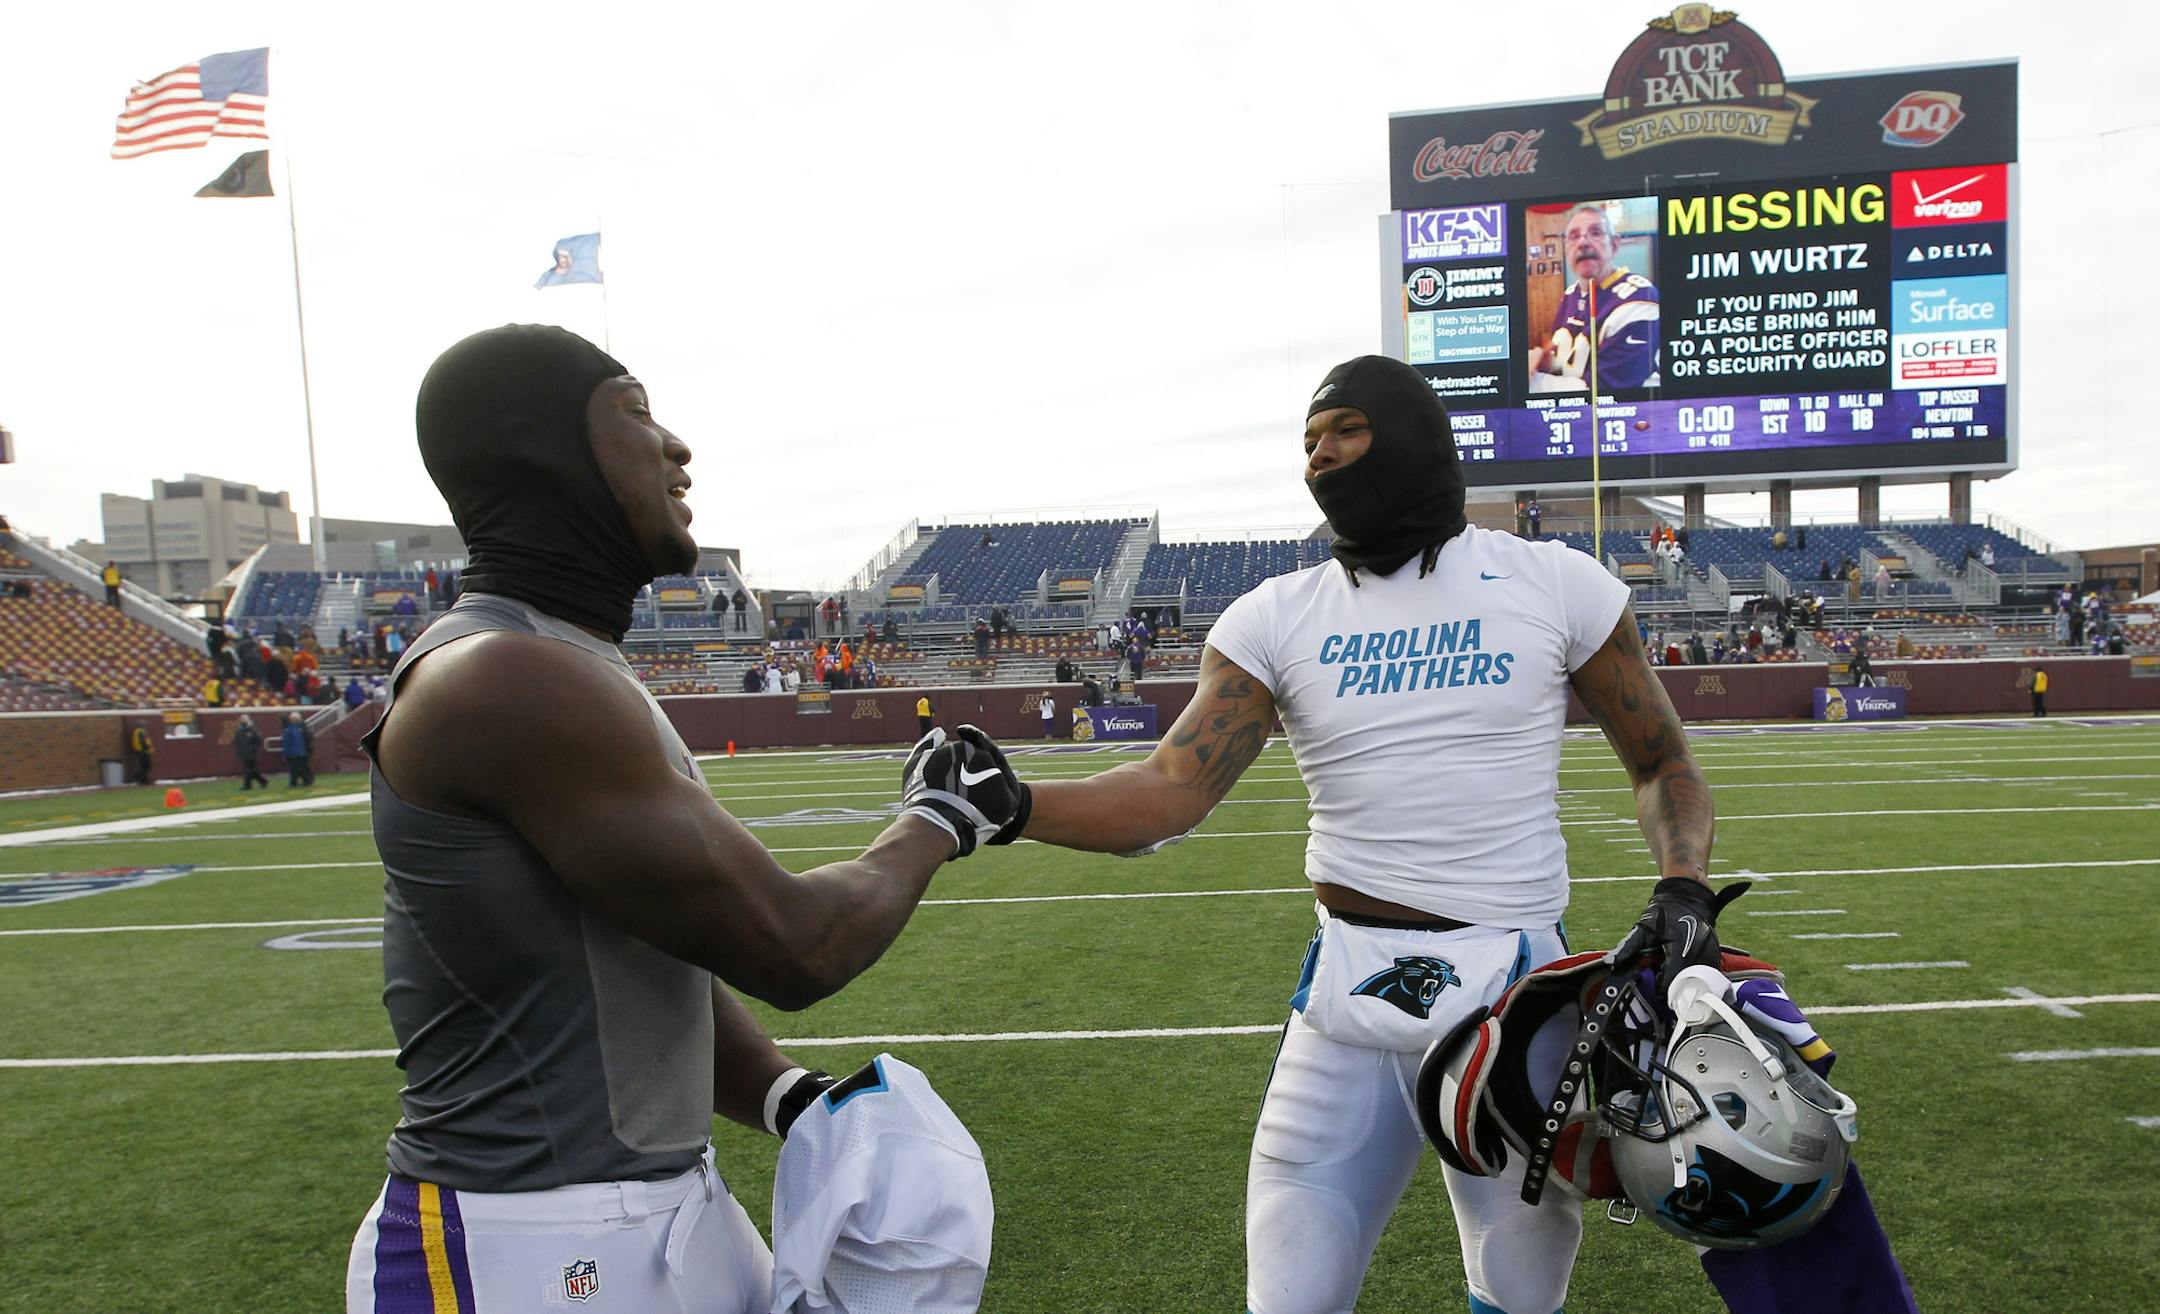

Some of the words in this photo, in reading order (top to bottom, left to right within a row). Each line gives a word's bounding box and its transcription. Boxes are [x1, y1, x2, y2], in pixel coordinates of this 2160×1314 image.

[1659, 42, 1730, 76] TCF
[1643, 69, 1744, 107] BANK
[1895, 103, 1951, 134] DQ
[1616, 111, 1772, 149] STADIUM
[1413, 129, 1545, 182] Coca-Cola
[1667, 183, 1885, 236] MISSING
[1913, 199, 1983, 219] verizon
[1406, 206, 1501, 246] KFAN
[1686, 251, 1740, 279] JIM
[1750, 243, 1868, 275] WURTZ
[1927, 243, 1993, 260] DELTA
[1445, 266, 1505, 286] JIMMY
[1445, 283, 1505, 302] JOHN'S
[1697, 298, 1716, 314] IF
[1720, 295, 1762, 313] YOU
[1768, 292, 1817, 310] FIND
[1823, 289, 1858, 307] JIM
[1437, 316, 1459, 325] With
[1459, 315, 1477, 324] You
[1478, 314, 1504, 325] Every
[1910, 298, 1995, 323] Surface
[1436, 327, 1457, 338] Step
[1458, 325, 1468, 335] of
[1468, 325, 1485, 334] the
[1485, 324, 1505, 335] Way
[1681, 316, 1757, 336] PLEASE
[1764, 311, 1829, 331] BRING
[1836, 309, 1876, 327] HIM
[1669, 340, 1695, 357] TO
[1700, 339, 1716, 355] A
[1721, 334, 1795, 354] POLICE
[1800, 329, 1888, 350] OFFICER
[1901, 338, 1997, 358] LOFFLER
[1672, 360, 1701, 377] OR
[1706, 354, 1807, 375] SECURITY
[1812, 350, 1886, 370] GUARD
[1759, 398, 1790, 412] DOWN
[1798, 396, 1813, 410] TO
[1815, 396, 1830, 409] GO
[1838, 394, 1865, 408] BALL
[1868, 393, 1884, 407] ON
[1918, 391, 1939, 406] TOP
[1940, 389, 1979, 405] PASSER
[1450, 415, 1486, 430] PASSER
[1678, 405, 1735, 433] 0:00
[1761, 414, 1789, 434] 1ST
[1803, 411, 1826, 432] 10
[1851, 408, 1874, 431] 18
[1925, 407, 1973, 423] NEWTON
[1550, 422, 1571, 443] 31
[1605, 420, 1627, 441] 13
[1709, 434, 1731, 447] 4TH
[1620, 442, 1628, 452] 3
[1319, 618, 1481, 665] CAROLINA
[1336, 652, 1514, 698] PANTHERS
[568, 1275, 596, 1295] NFL
